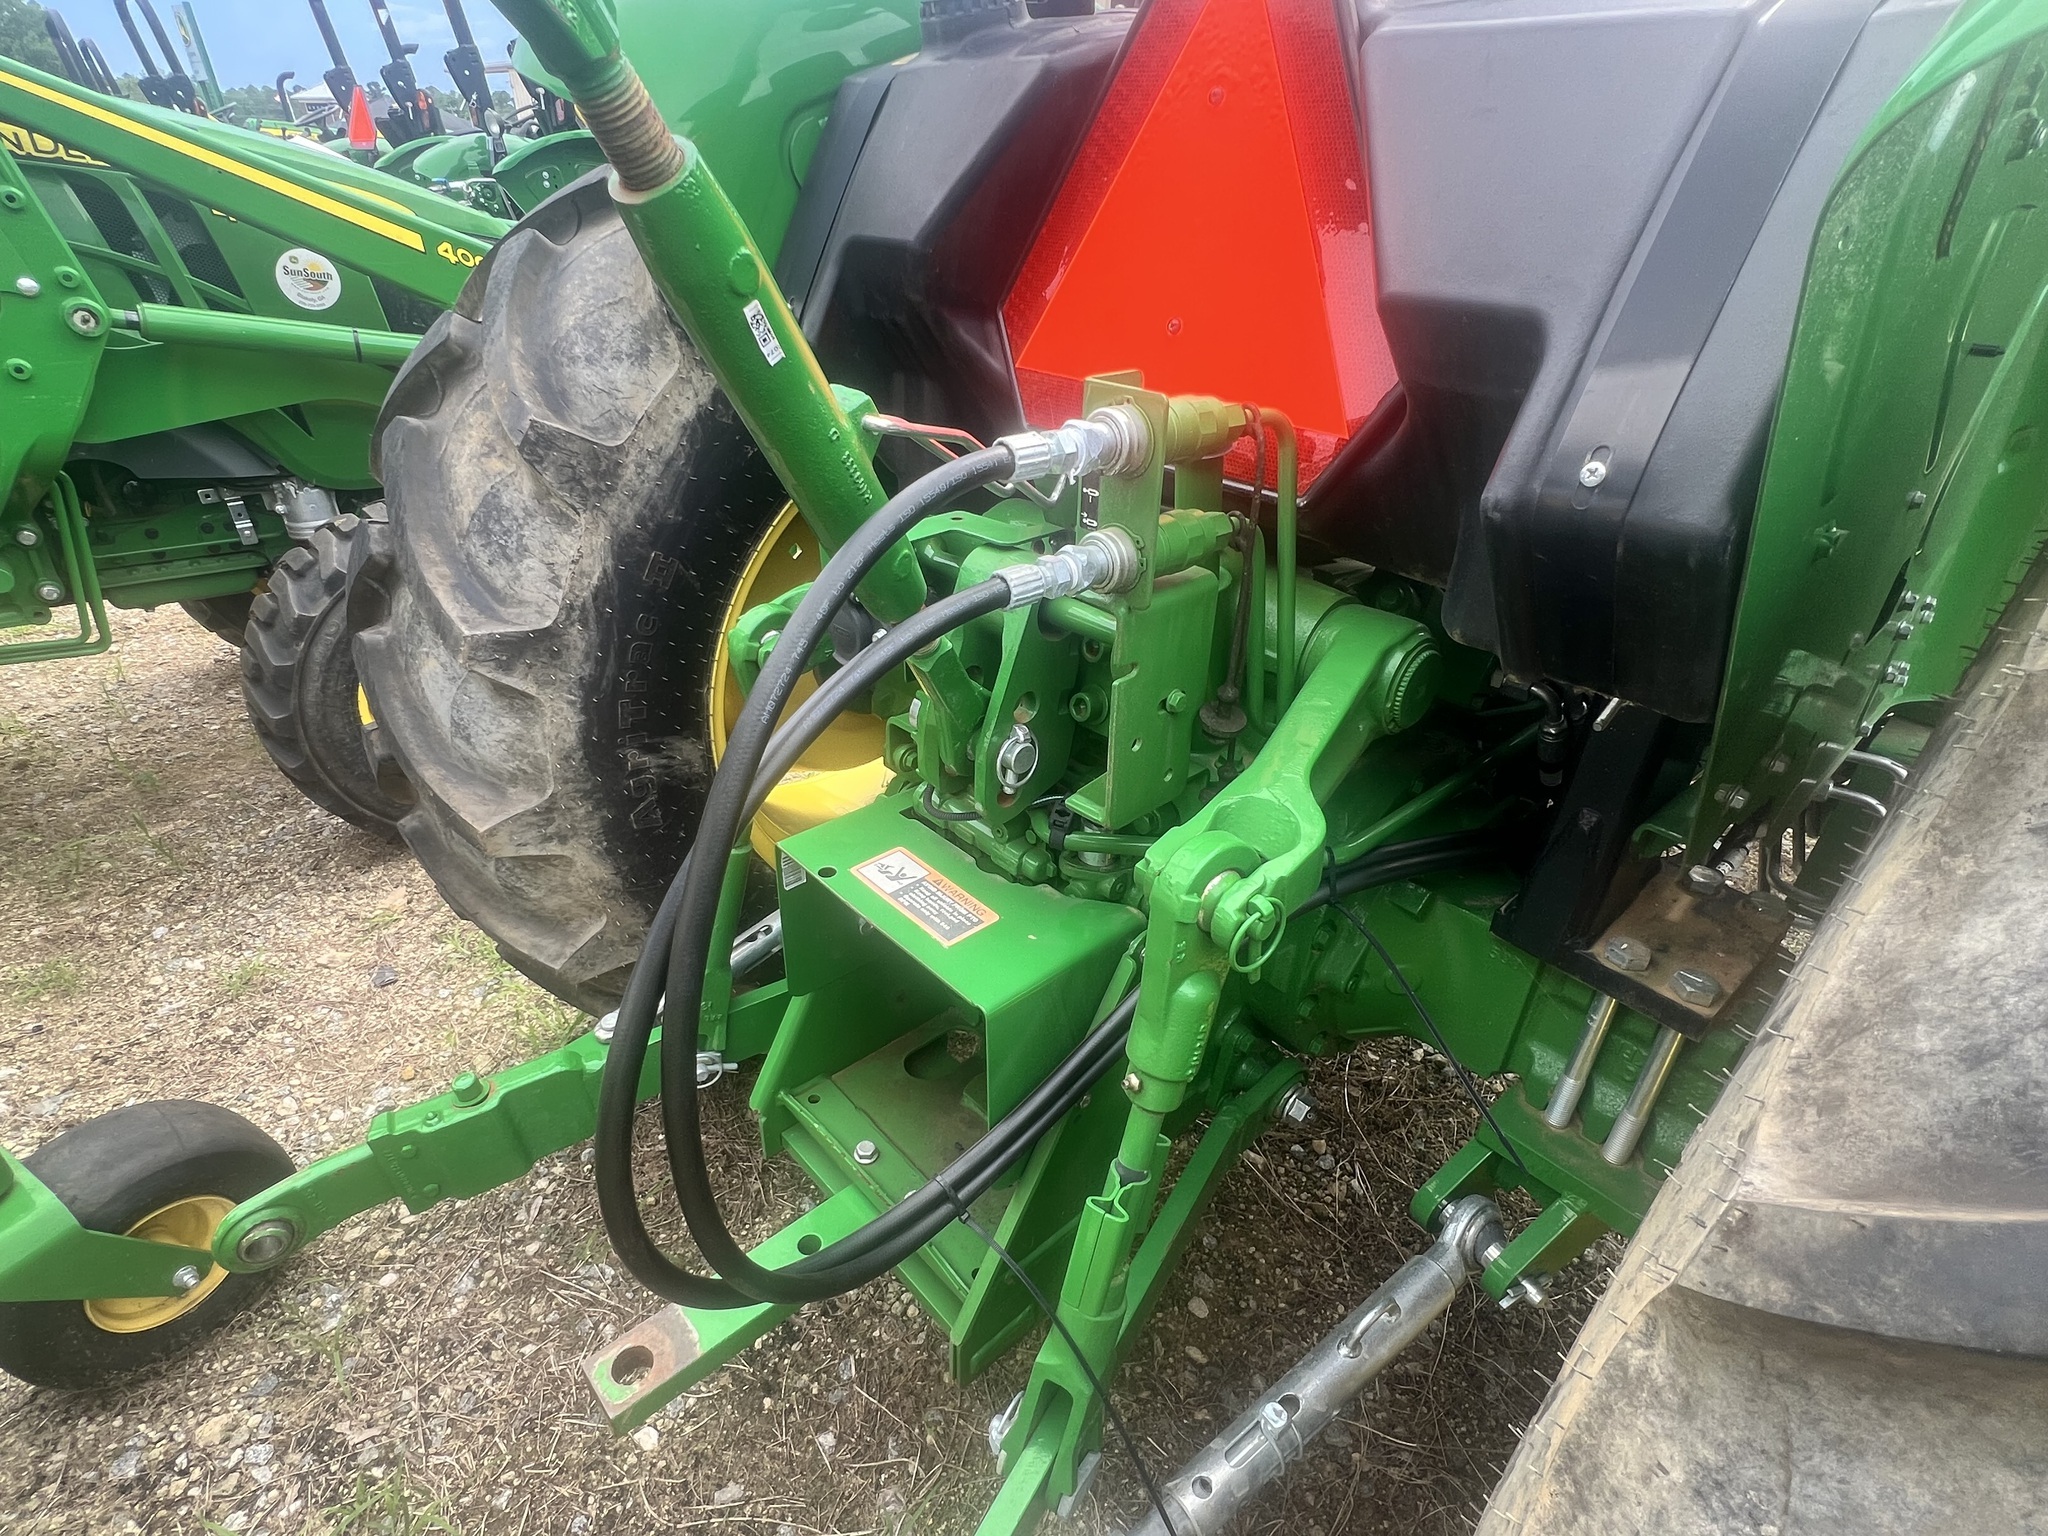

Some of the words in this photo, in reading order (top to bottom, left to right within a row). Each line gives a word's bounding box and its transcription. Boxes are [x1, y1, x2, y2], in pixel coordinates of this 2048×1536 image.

[282, 265, 333, 281] SunSouth
[791, 639, 809, 660] 745
[832, 581, 846, 596] to
[844, 552, 865, 580] 212F
[868, 523, 896, 552] Meets
[898, 505, 916, 523] ISO
[618, 612, 663, 830] AgriTrac
[941, 883, 987, 917] WARNING
